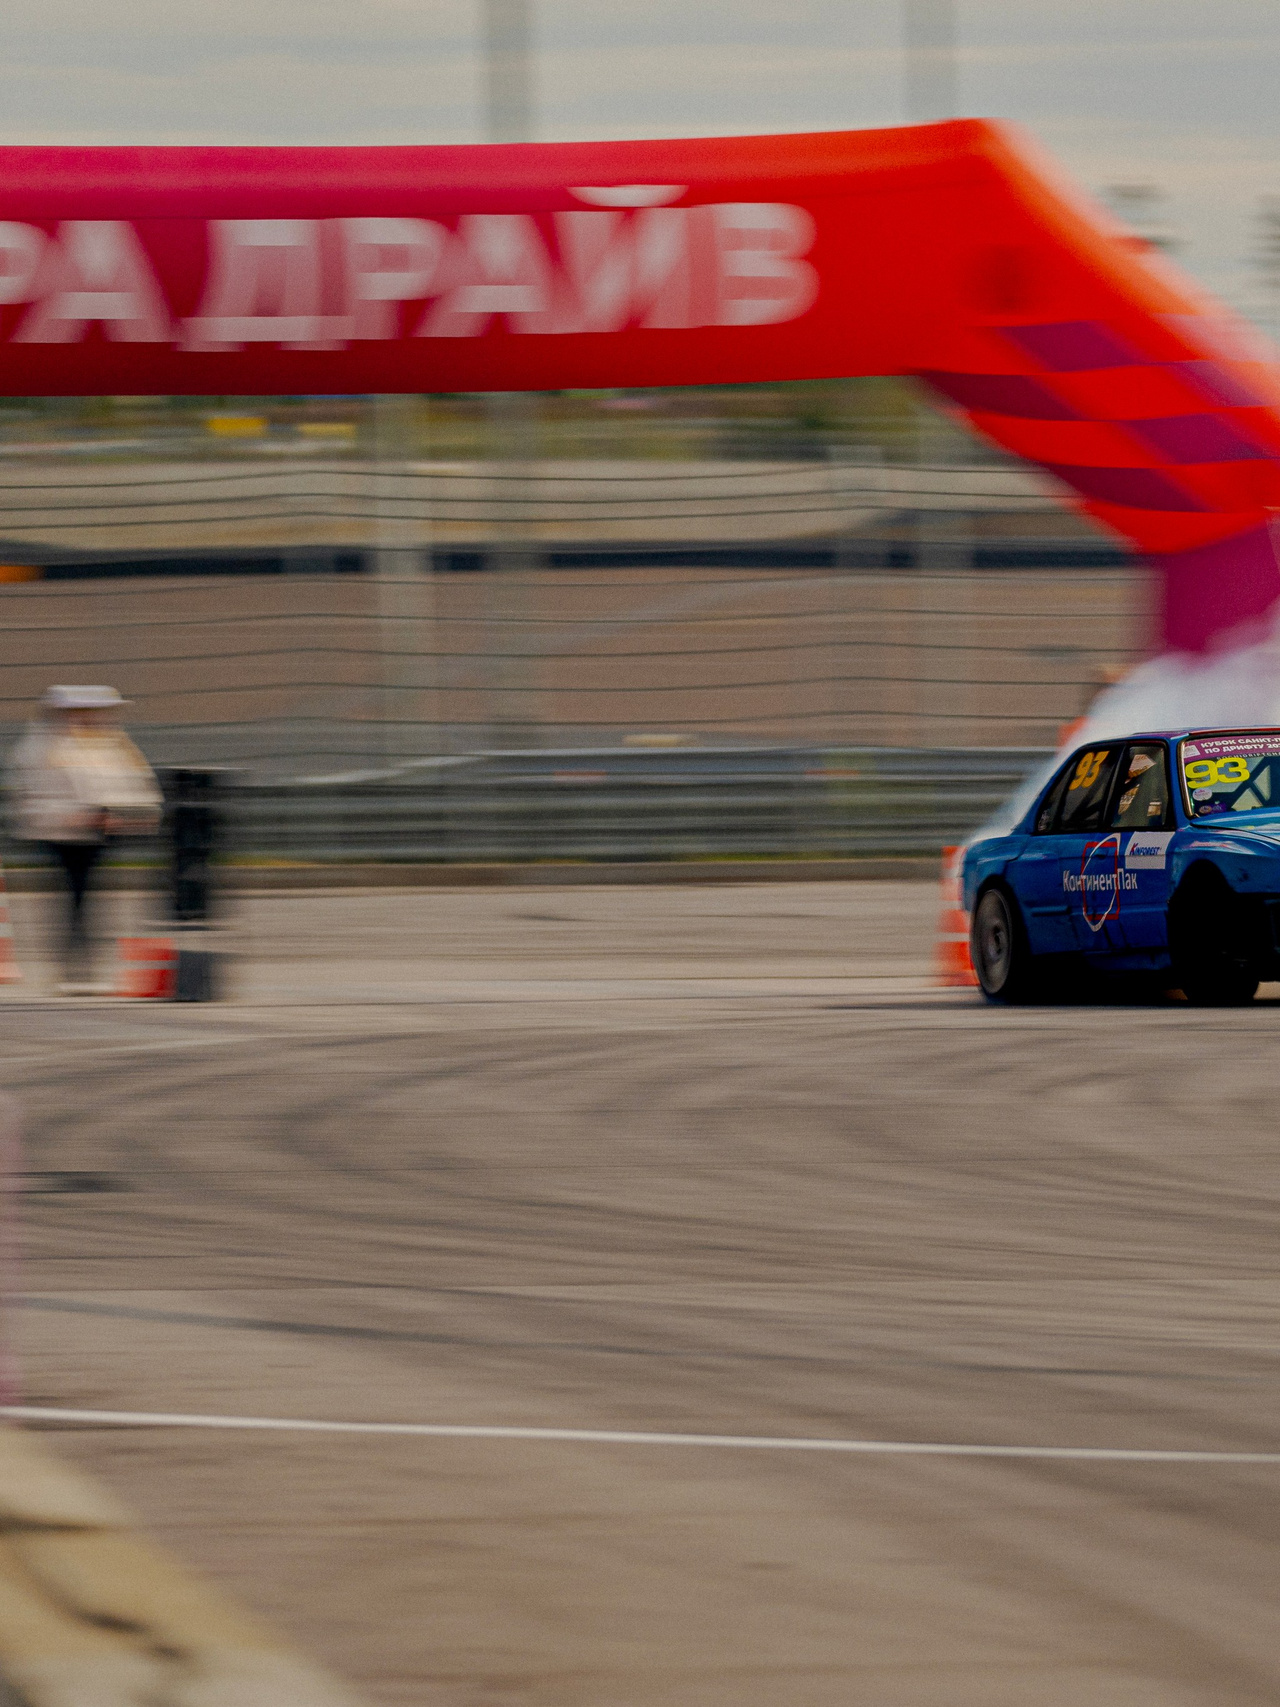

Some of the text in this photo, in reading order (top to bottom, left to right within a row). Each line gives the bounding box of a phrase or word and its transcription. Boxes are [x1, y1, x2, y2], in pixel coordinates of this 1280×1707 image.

[174, 184, 819, 352] ДРАЙВ
[1200, 740, 1236, 749] КУБОК
[1222, 743, 1264, 753] ДРИФТУ
[1068, 751, 1110, 790] 93
[1185, 757, 1251, 789] 93
[1063, 868, 1138, 892] КонтинентПак
